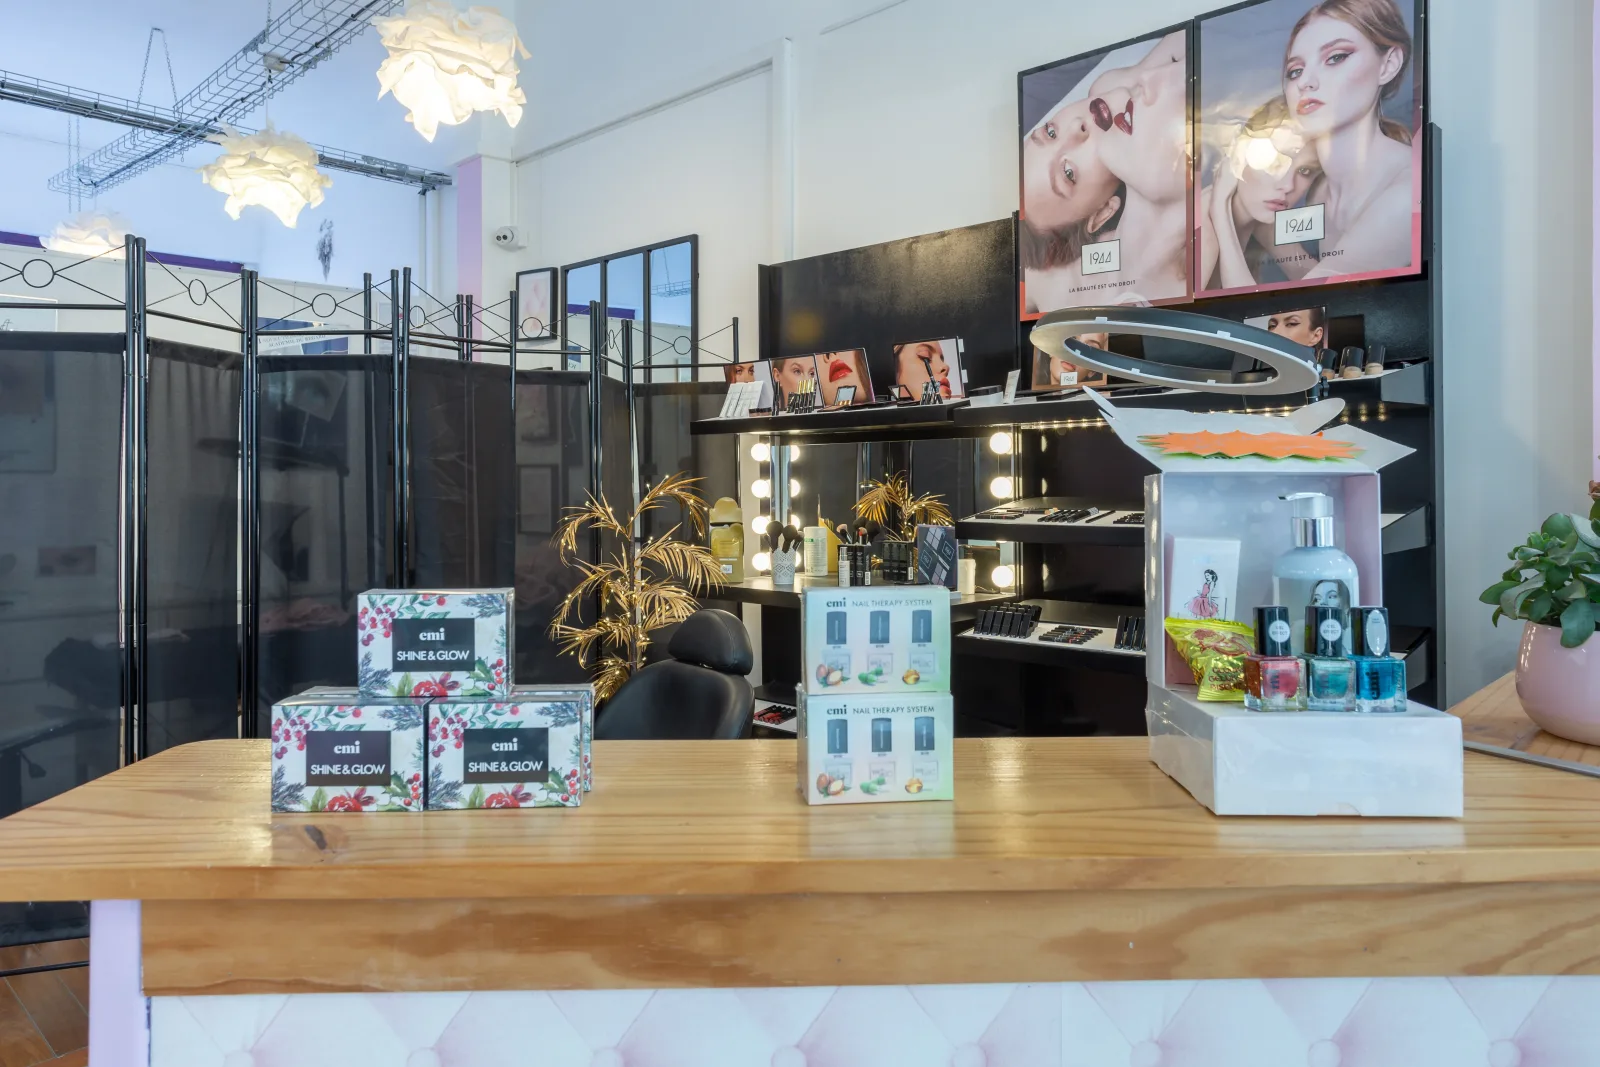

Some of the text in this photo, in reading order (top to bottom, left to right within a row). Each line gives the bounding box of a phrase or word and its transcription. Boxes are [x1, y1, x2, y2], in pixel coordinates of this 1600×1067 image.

[1321, 249, 1345, 258] DROIT
[1118, 279, 1136, 287] DROIT
[826, 597, 847, 608] emi
[852, 600, 870, 608] NAIL
[871, 599, 903, 607] THERAPY
[419, 627, 445, 641] emi
[826, 704, 848, 715] emi
[872, 706, 904, 714] THERAPY
[906, 705, 935, 713] SYSTEM
[333, 740, 360, 754] emi
[491, 737, 518, 751] emi
